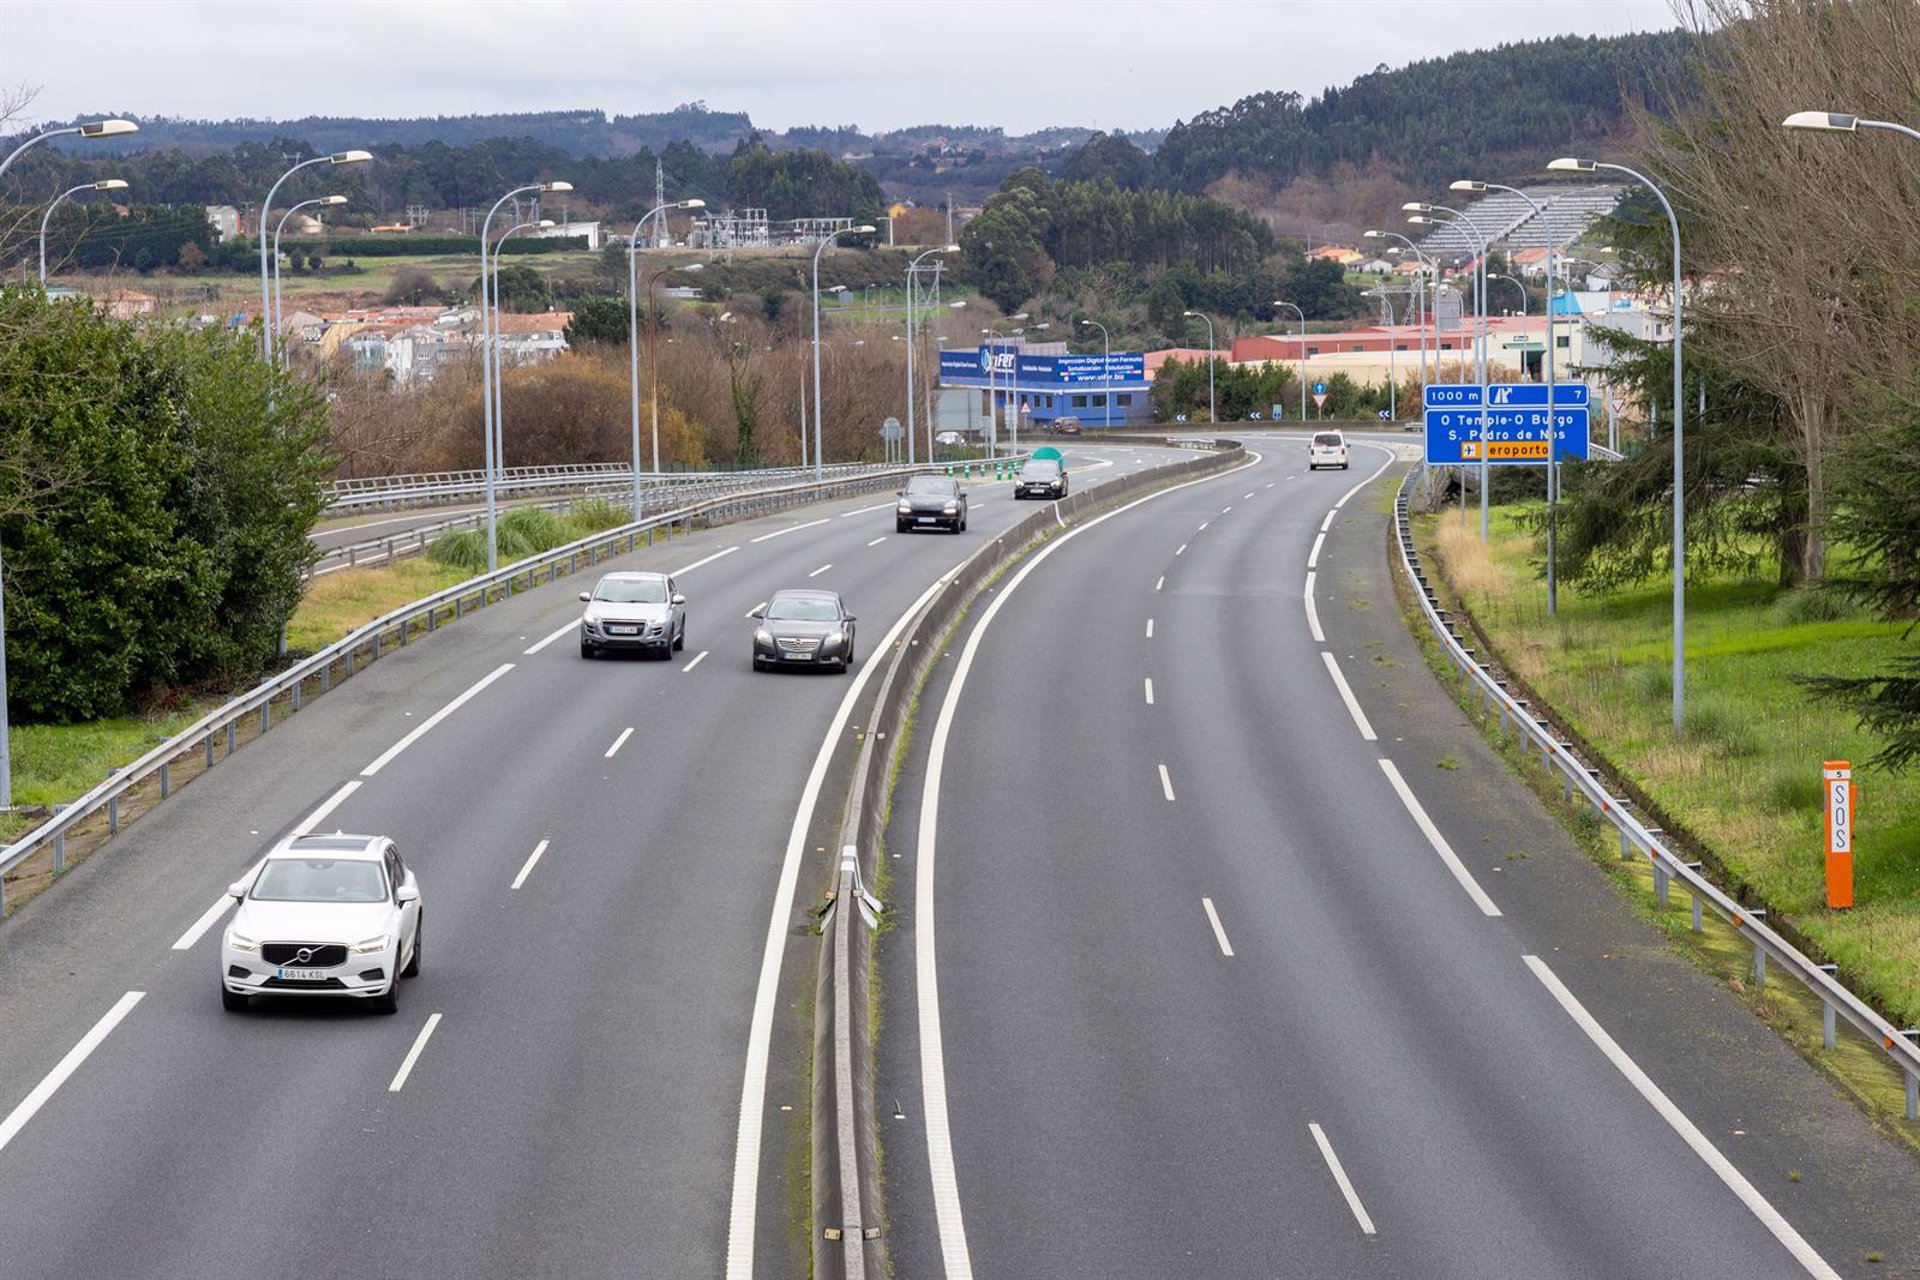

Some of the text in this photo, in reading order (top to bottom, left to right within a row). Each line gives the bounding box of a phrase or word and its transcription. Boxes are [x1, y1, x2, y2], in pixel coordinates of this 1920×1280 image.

[1432, 391, 1479, 401] 1000 m
[1574, 390, 1582, 400] 7
[1441, 415, 1450, 426] O
[1532, 414, 1574, 427] Bugo
[1448, 430, 1462, 441] S.
[1517, 430, 1532, 440] de
[1487, 444, 1549, 457] eroporto
[1835, 785, 1845, 848] SOS
